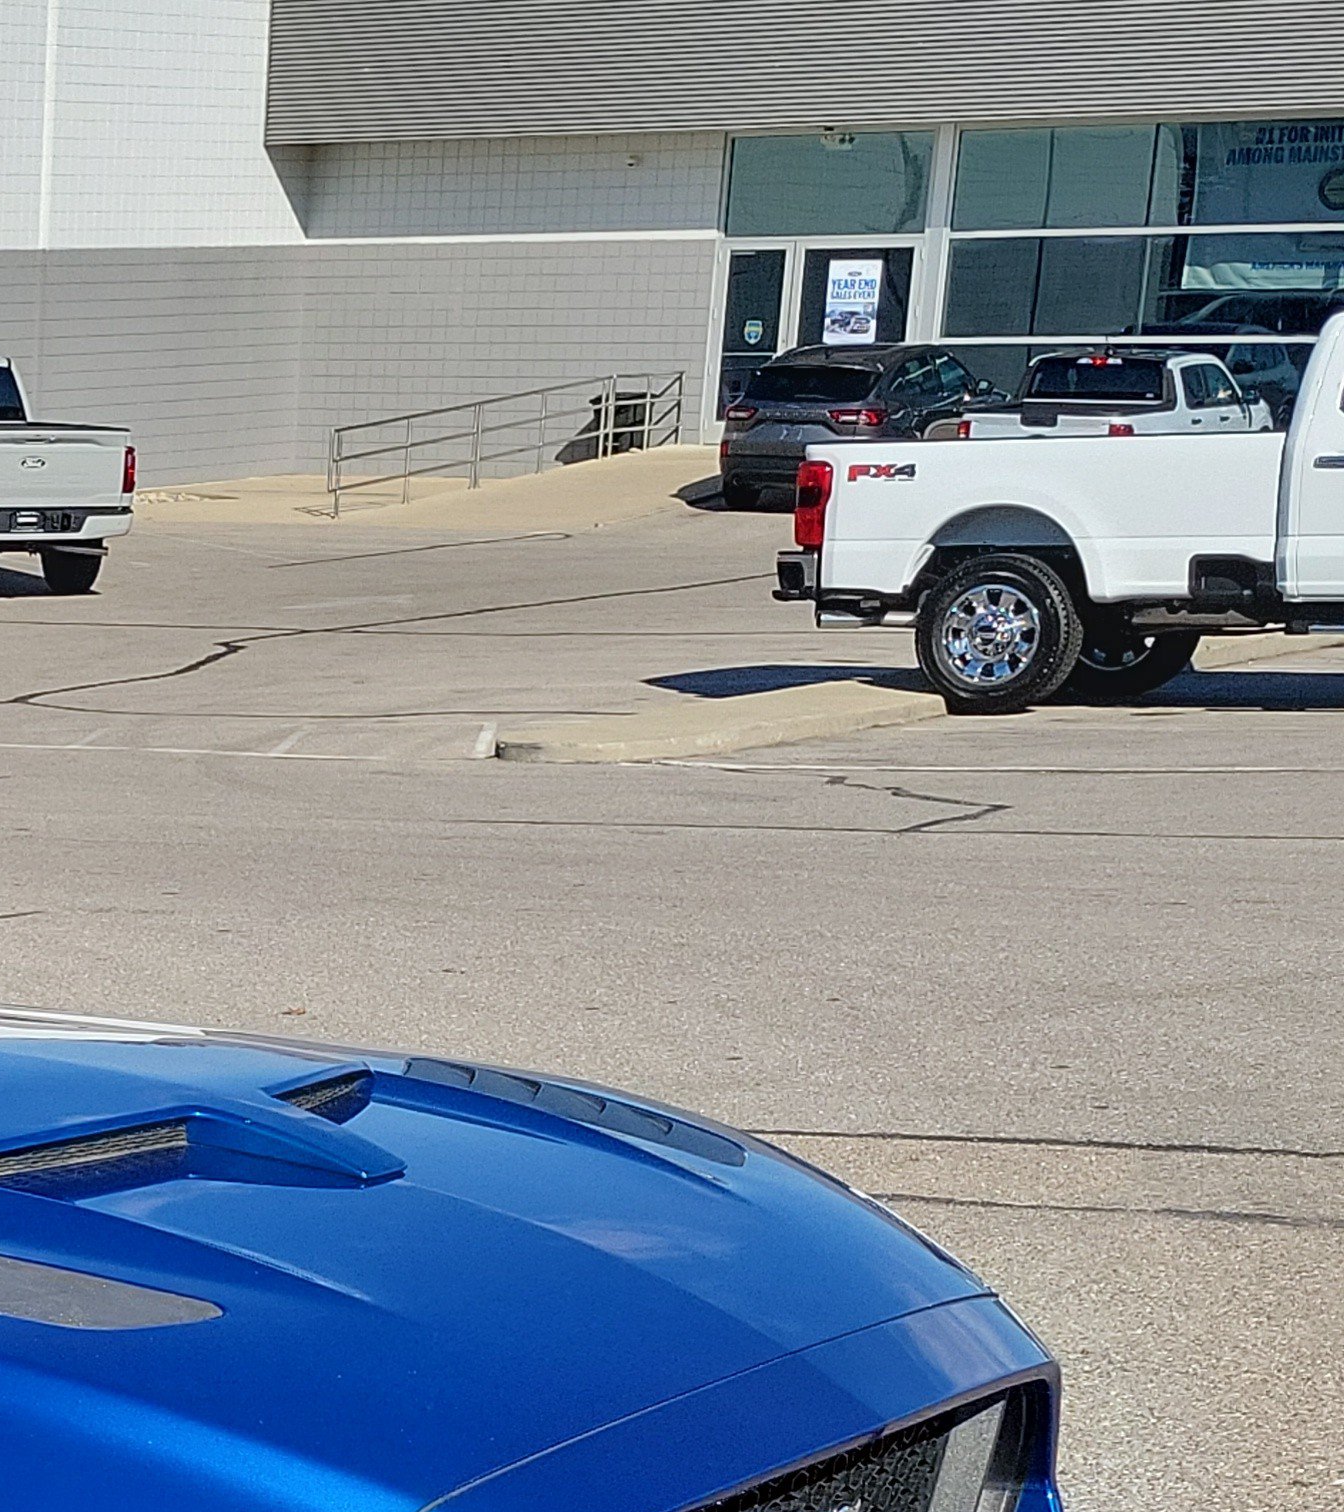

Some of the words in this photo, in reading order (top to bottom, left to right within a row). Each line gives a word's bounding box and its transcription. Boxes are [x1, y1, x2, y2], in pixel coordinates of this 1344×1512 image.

[1278, 125, 1312, 144] FOR
[1225, 145, 1285, 166] AMONG
[1288, 144, 1344, 164] MAINS
[832, 279, 857, 290] YEAR
[858, 278, 877, 290] END
[846, 463, 917, 483] FX4
